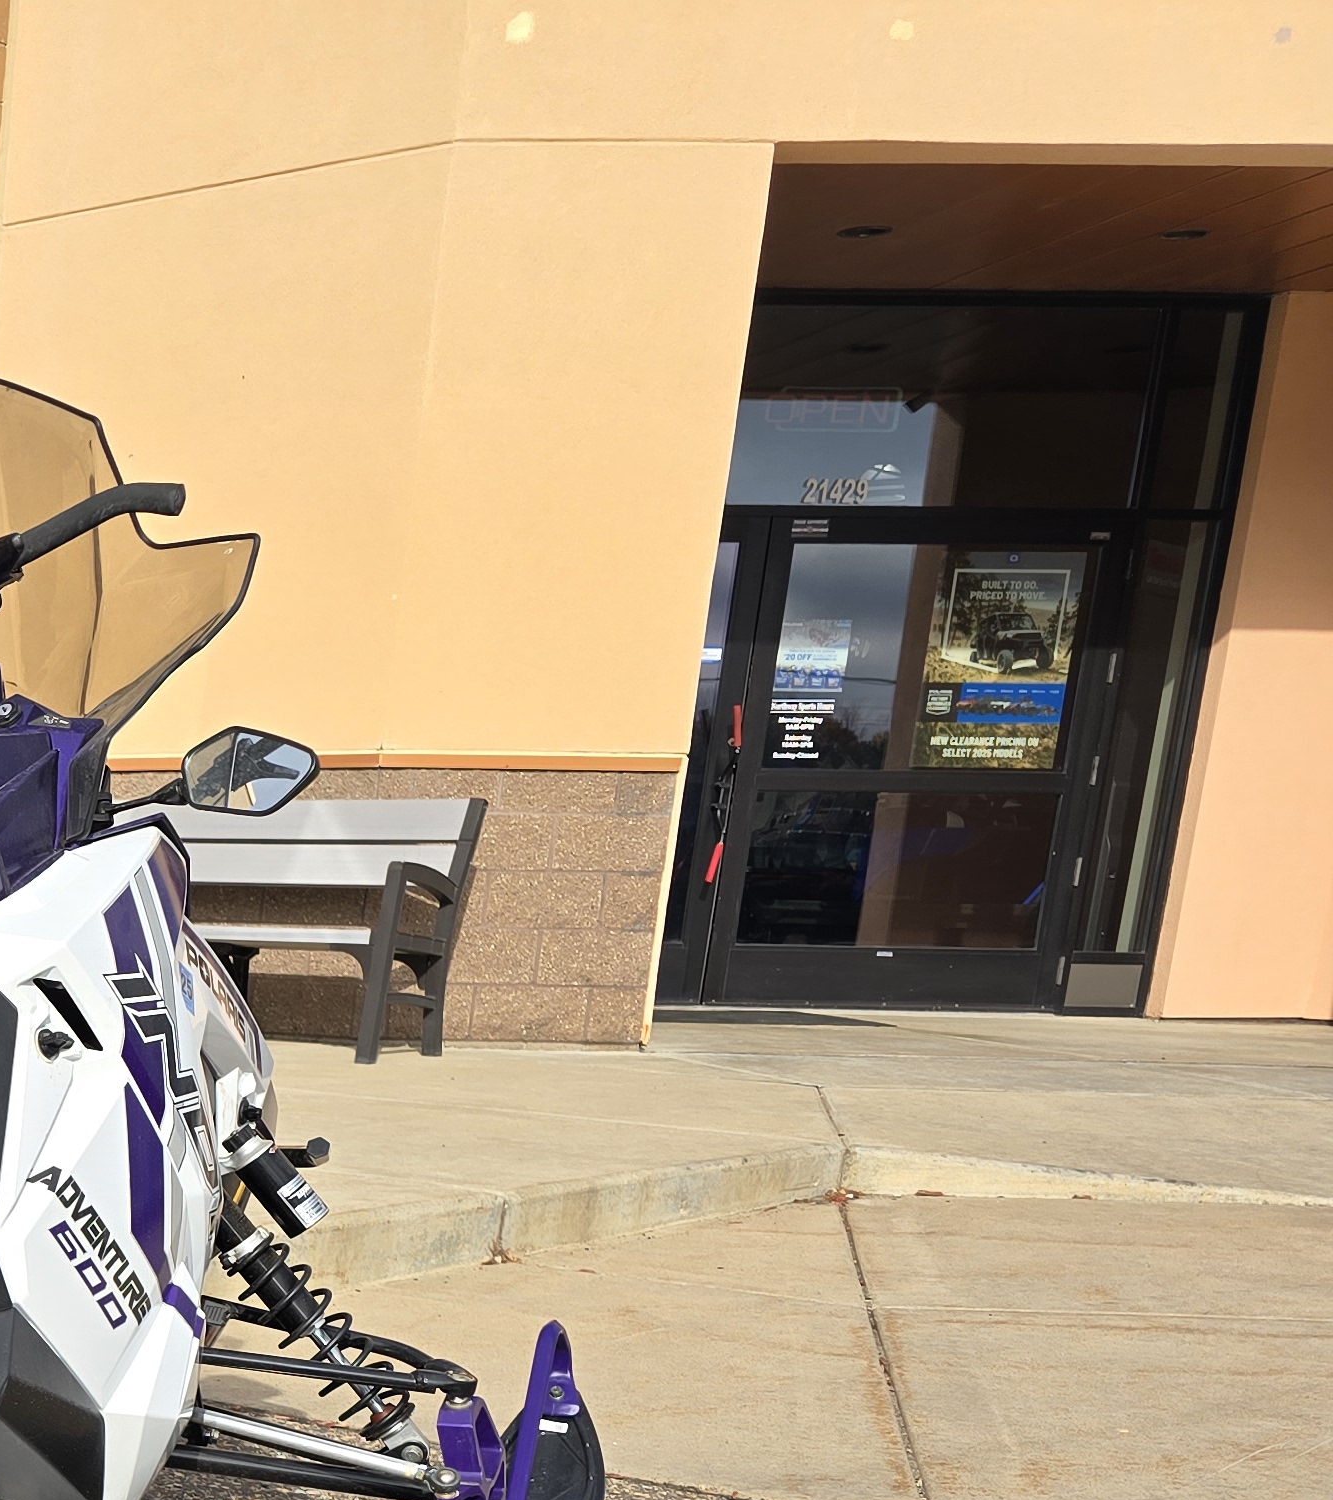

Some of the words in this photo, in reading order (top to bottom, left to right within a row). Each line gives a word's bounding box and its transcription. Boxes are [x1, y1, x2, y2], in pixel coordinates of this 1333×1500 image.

[765, 393, 891, 424] OPEN
[802, 478, 869, 505] 21429
[969, 590, 1004, 601] PRICED
[1005, 591, 1018, 601] TO
[981, 580, 1008, 590] BUILT
[1009, 580, 1022, 590] TO
[1023, 580, 1039, 590] GO.
[796, 653, 813, 661] OFF
[930, 736, 948, 746] NEW
[949, 736, 995, 747] CLEARANCE
[996, 737, 1027, 747] PRICING
[1027, 737, 1040, 747] ON
[942, 747, 972, 758] SELECT
[972, 748, 992, 758] 2025
[992, 749, 1024, 759] MODELS
[180, 972, 194, 1001] 25
[185, 938, 247, 1044] POLARIS
[26, 1165, 152, 1327] ADVENTURE
[48, 1220, 127, 1330] 600
